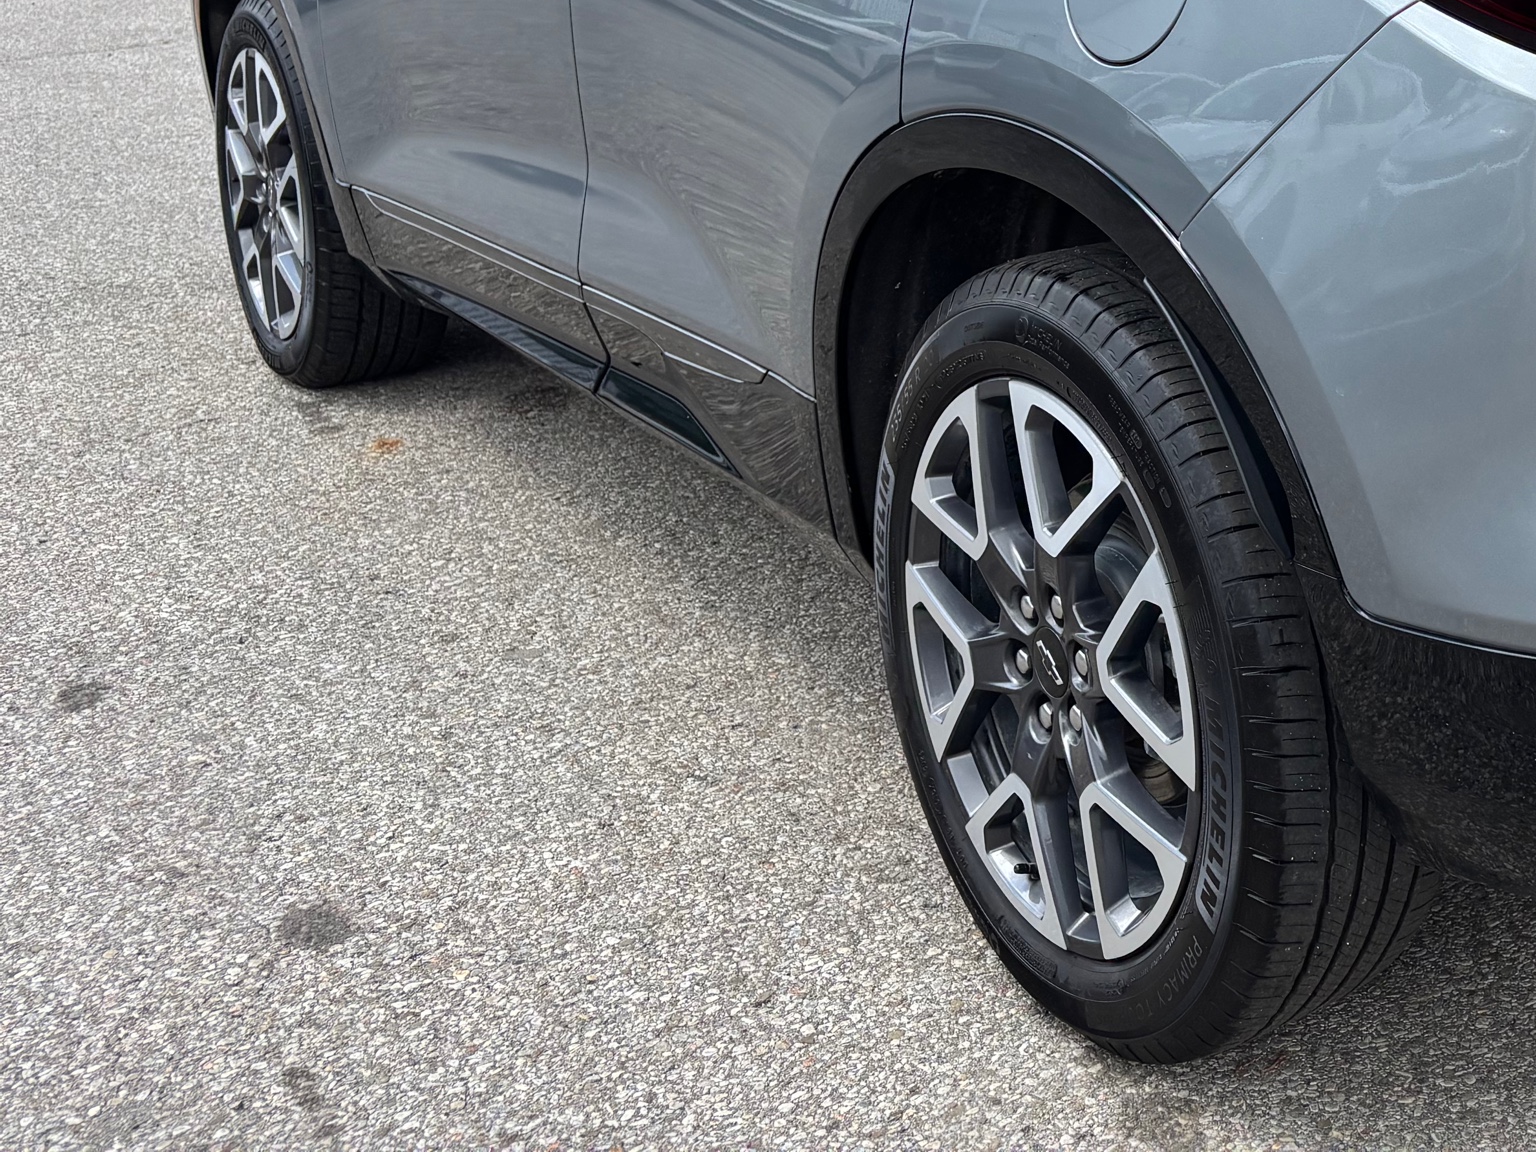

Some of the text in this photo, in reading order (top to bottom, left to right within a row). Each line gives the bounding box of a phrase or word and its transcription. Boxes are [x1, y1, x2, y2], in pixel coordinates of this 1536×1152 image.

[875, 459, 891, 646] MICHELIN
[1200, 695, 1227, 919] MICHELIN
[1157, 934, 1203, 1006] PRIMACY
